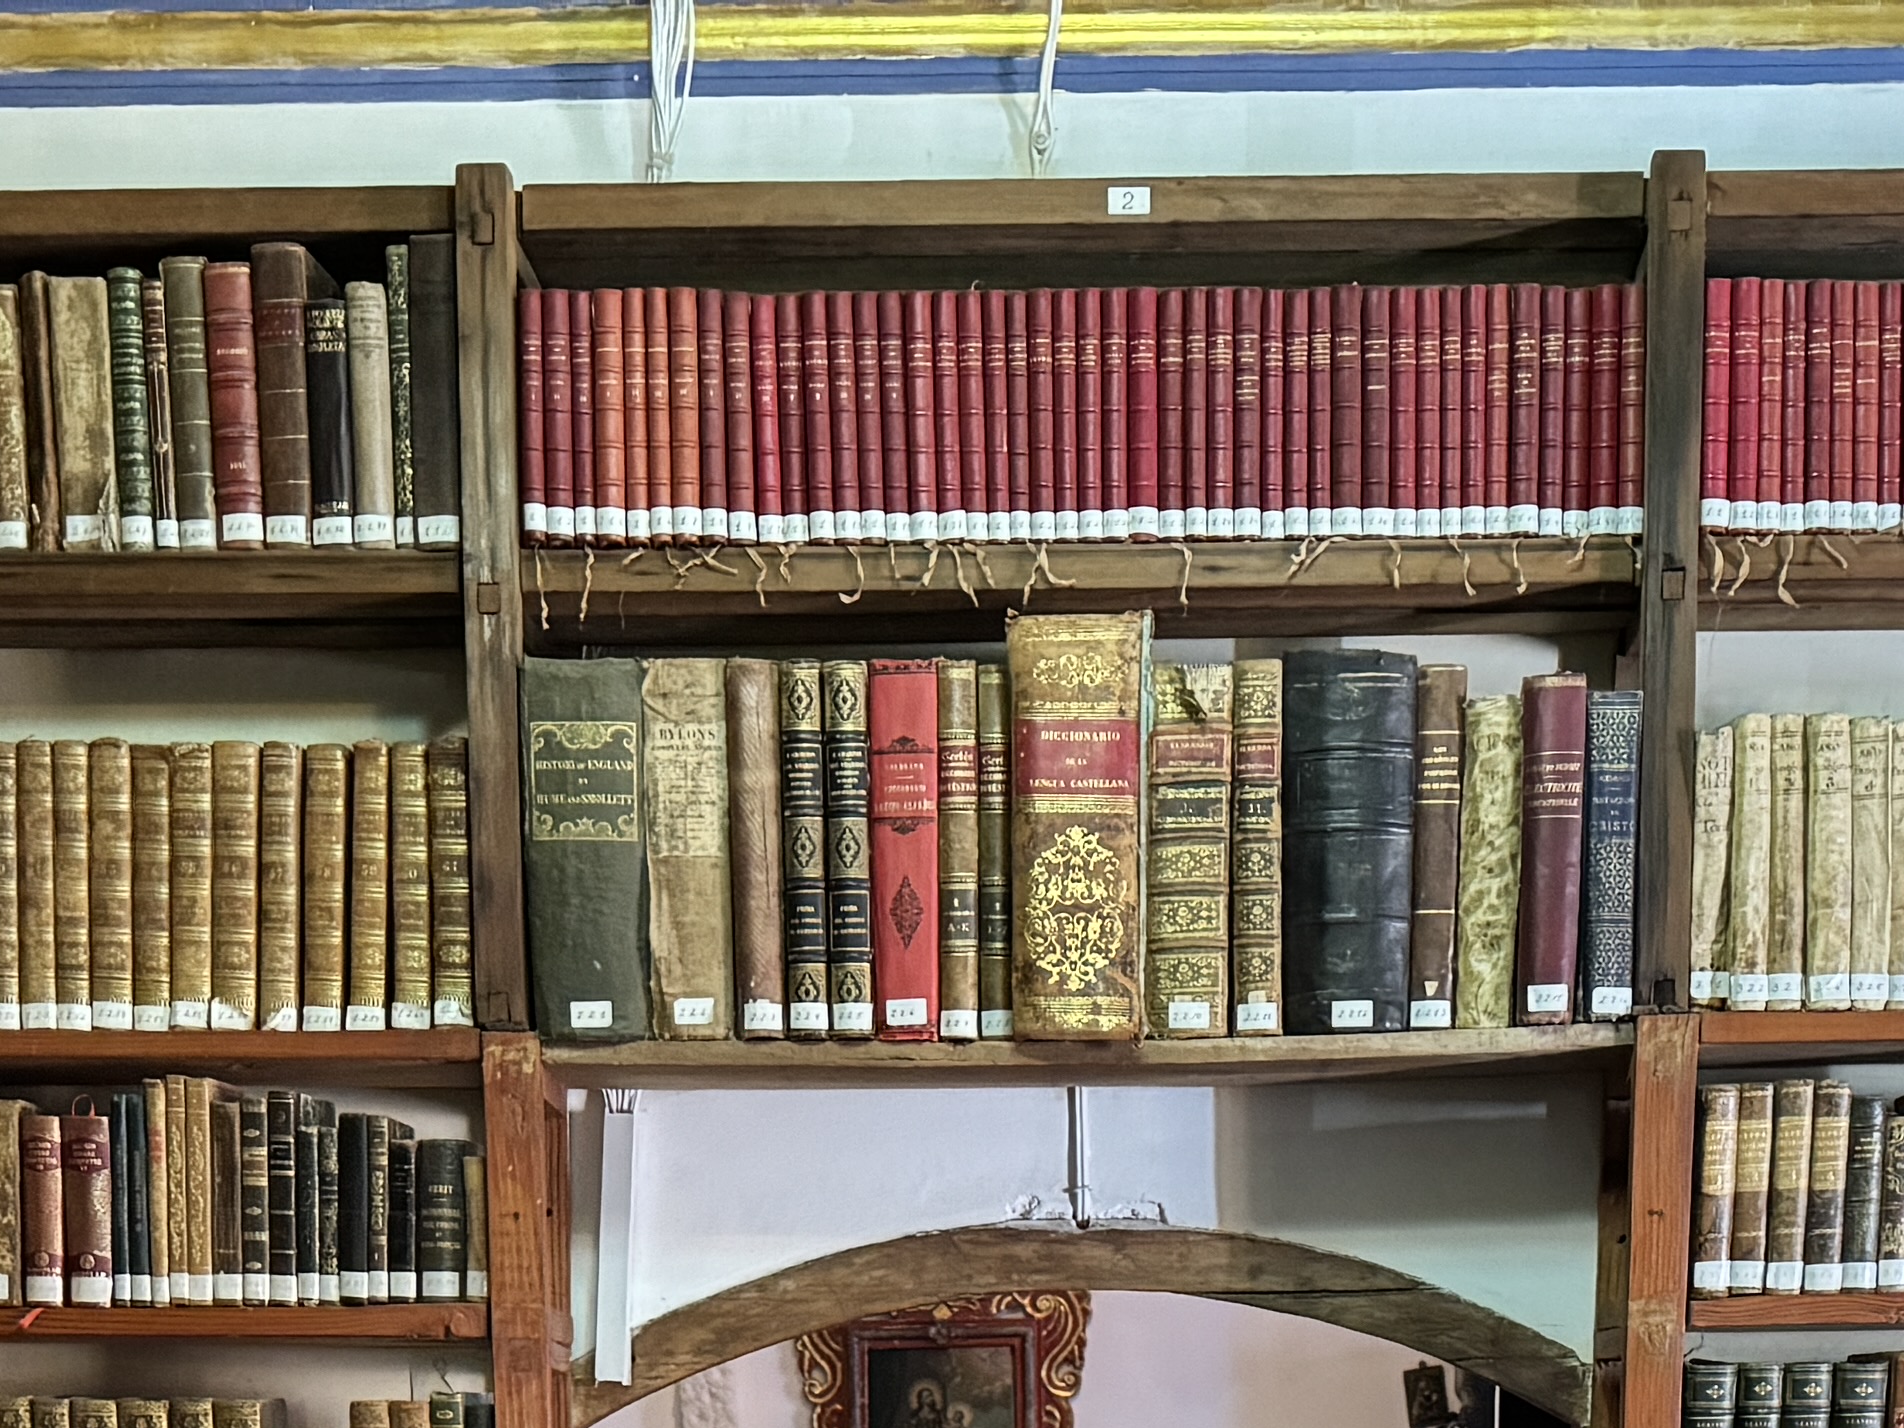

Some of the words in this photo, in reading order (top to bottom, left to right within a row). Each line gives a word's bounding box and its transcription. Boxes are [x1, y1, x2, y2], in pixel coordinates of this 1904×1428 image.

[1121, 190, 1136, 211] 2
[1041, 730, 1121, 742] DICCIONARIO
[536, 760, 575, 771] HISTORY
[587, 759, 634, 771] ENGLAND
[1029, 779, 1066, 788] LENGUA
[1070, 778, 1130, 789] CASTELLANA
[536, 794, 567, 806] HUME
